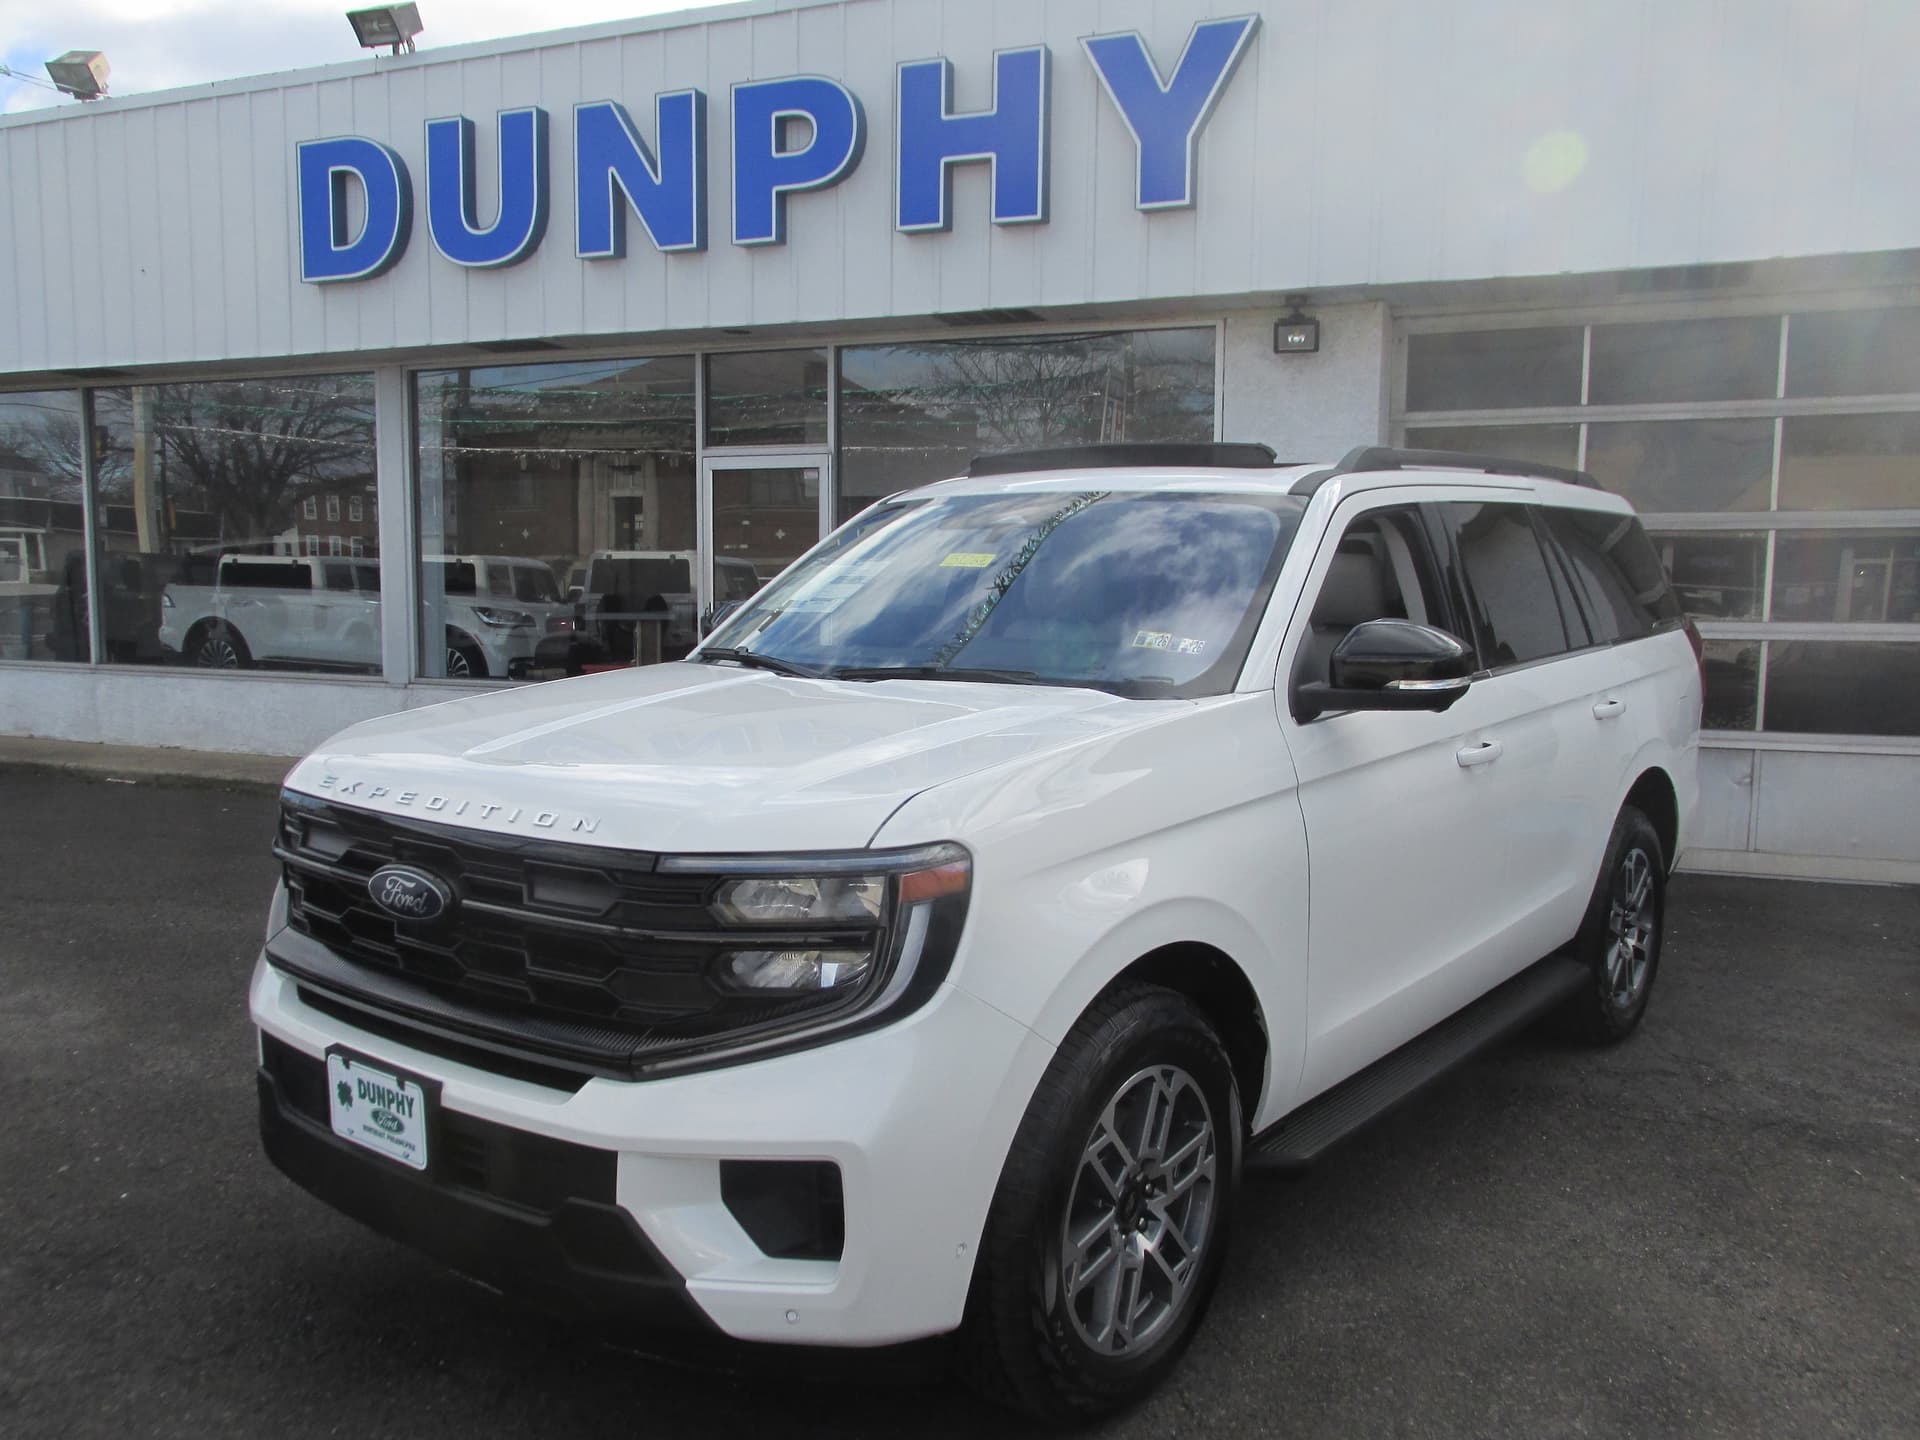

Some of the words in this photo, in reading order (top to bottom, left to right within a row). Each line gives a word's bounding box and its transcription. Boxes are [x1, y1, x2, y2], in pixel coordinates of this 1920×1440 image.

[296, 13, 1260, 283] DUNPHY
[318, 775, 601, 834] EXPEDITION
[380, 875, 429, 914] Ford
[357, 1077, 415, 1119] DUNPHY
[376, 1112, 399, 1130] Ford
